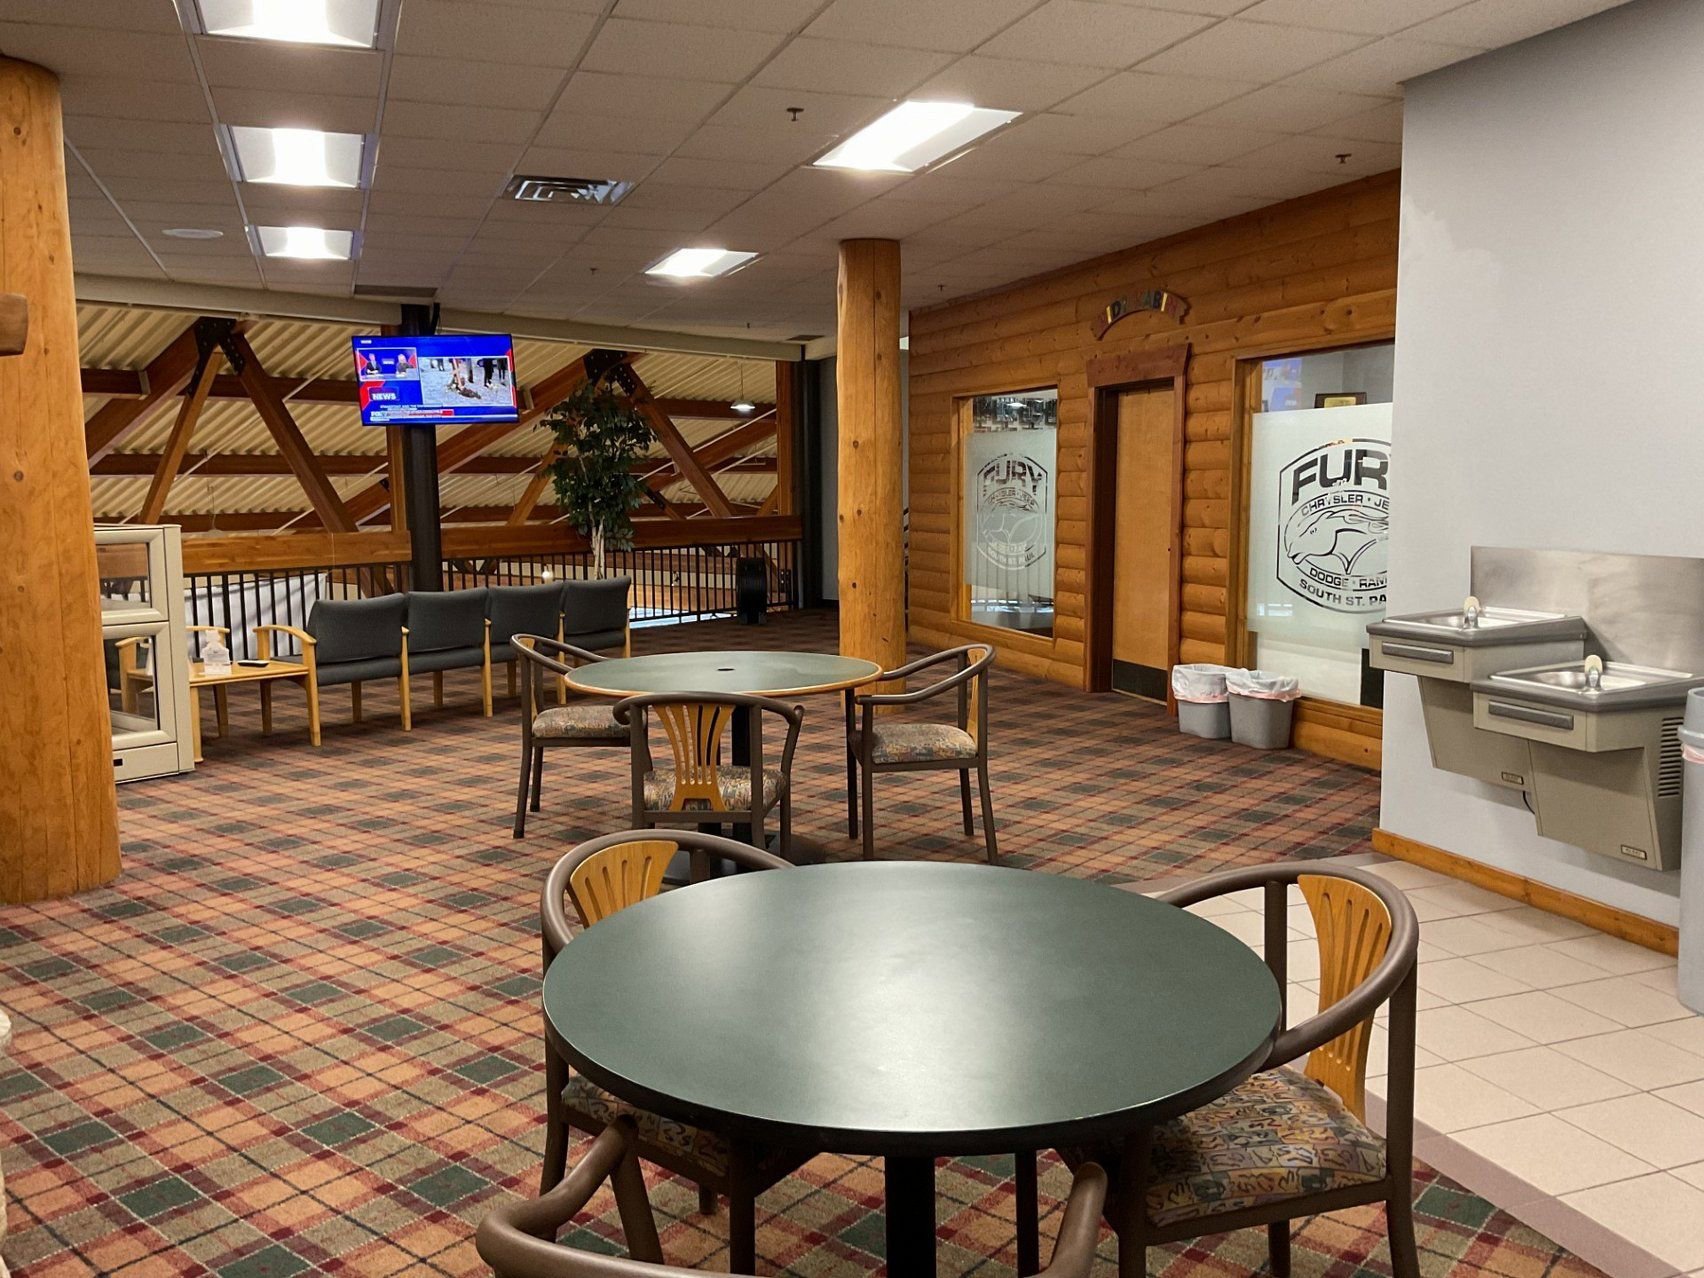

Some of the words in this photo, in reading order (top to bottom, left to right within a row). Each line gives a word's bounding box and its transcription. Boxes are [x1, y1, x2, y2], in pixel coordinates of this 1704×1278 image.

[372, 392, 397, 401] NEWS
[983, 460, 1042, 498] FURY
[1292, 449, 1390, 506] FUR
[1374, 500, 1390, 511] JE
[1309, 567, 1350, 588] DODGE
[1299, 579, 1342, 605] SOUTH
[1345, 596, 1366, 607] ST.
[1369, 594, 1387, 607] PA
